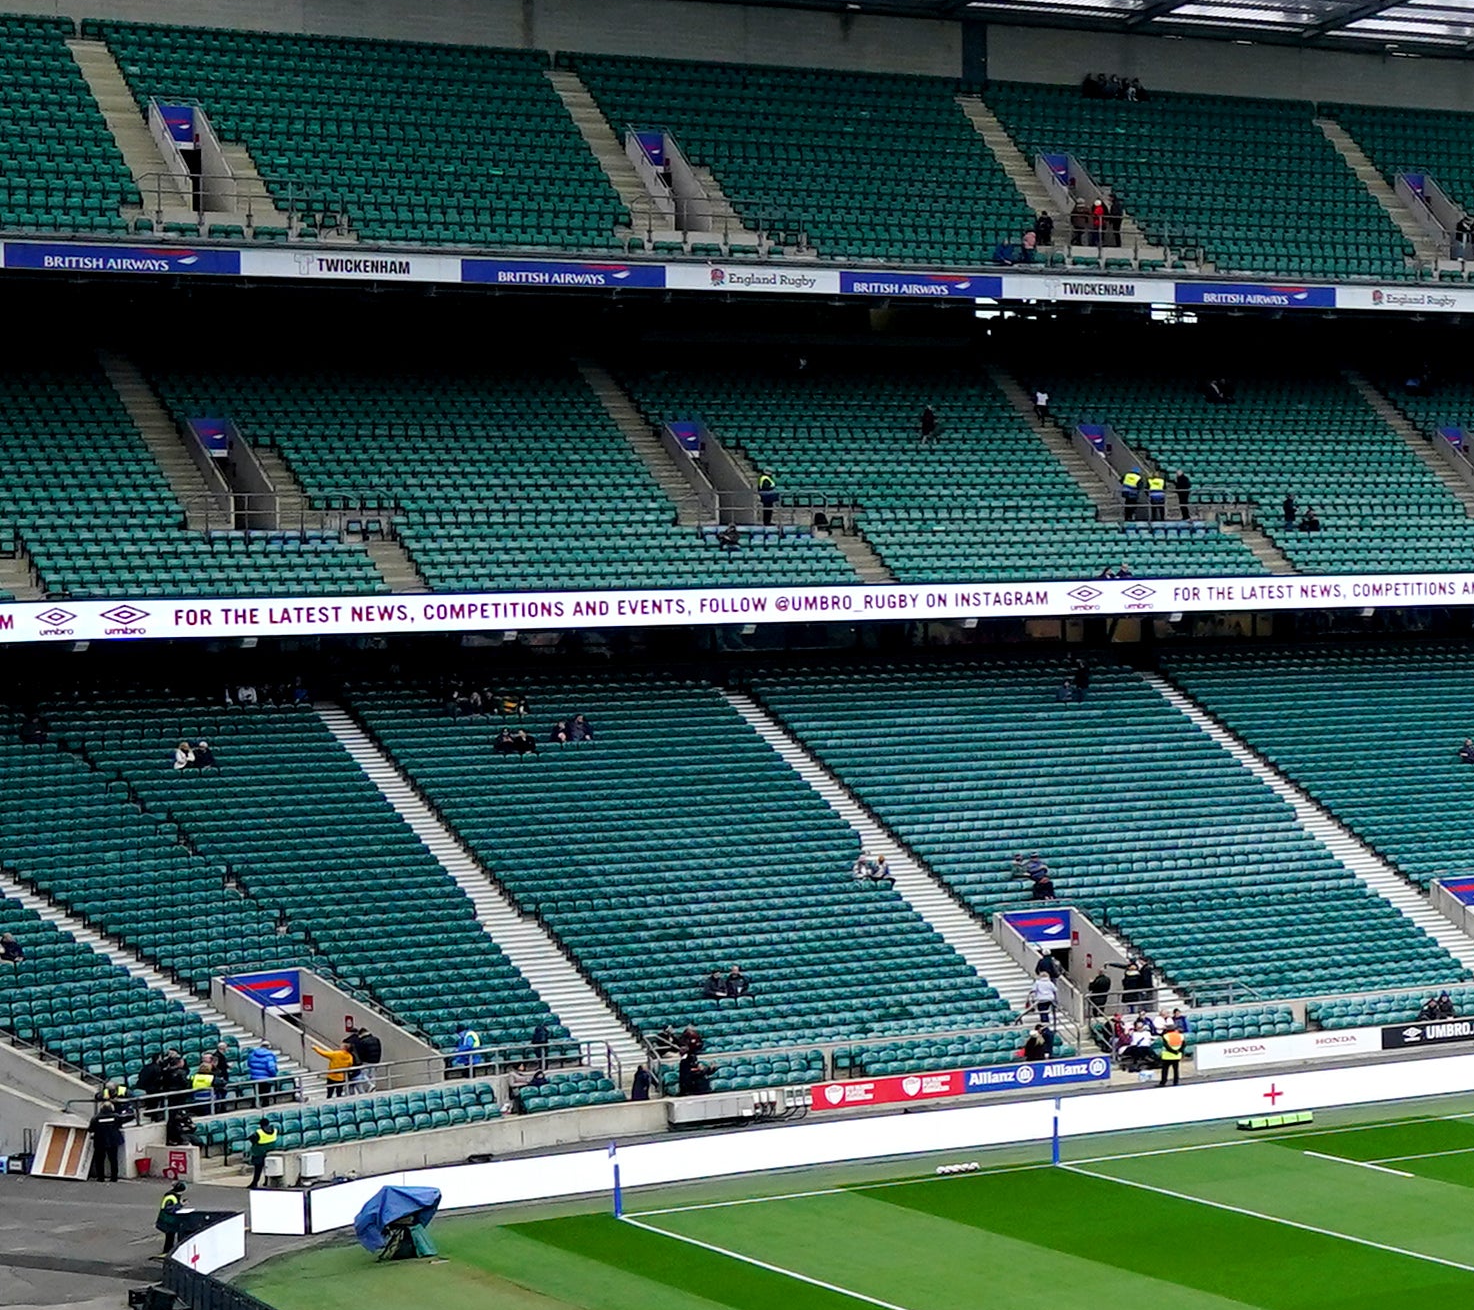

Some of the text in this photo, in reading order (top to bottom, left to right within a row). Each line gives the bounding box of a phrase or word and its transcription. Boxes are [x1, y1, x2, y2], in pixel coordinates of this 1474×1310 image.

[44, 256, 170, 272] BRITISH AIRWAYS
[317, 258, 411, 275] TWICKENHAM
[498, 272, 604, 285] BRITISH AIRWAYS
[729, 273, 816, 289] England Rugby
[854, 283, 948, 295] BRITISH AIRWAYS
[1062, 283, 1134, 297] TWICKENHAM
[1204, 293, 1288, 305] BRITISH AIRWAYS
[1385, 294, 1456, 307] England Rugby
[1174, 587, 1200, 601] FOR
[1207, 586, 1234, 600] THE
[1242, 585, 1293, 600] LATEST
[1300, 584, 1346, 599] NEWS,
[1353, 582, 1455, 597] COMPETITIONS
[175, 591, 1048, 626] FOR THE LATEST NEWS, COMPETITIONS AND EVENTS, FOLLOW @UMBRO_RUGBY ON INSTAGRAM
[104, 627, 146, 635] umbro
[1315, 1035, 1357, 1045] HONDA
[1223, 1044, 1266, 1055] HONDA
[1043, 1063, 1088, 1078] Allianz
[969, 1072, 1015, 1086] Allianz
